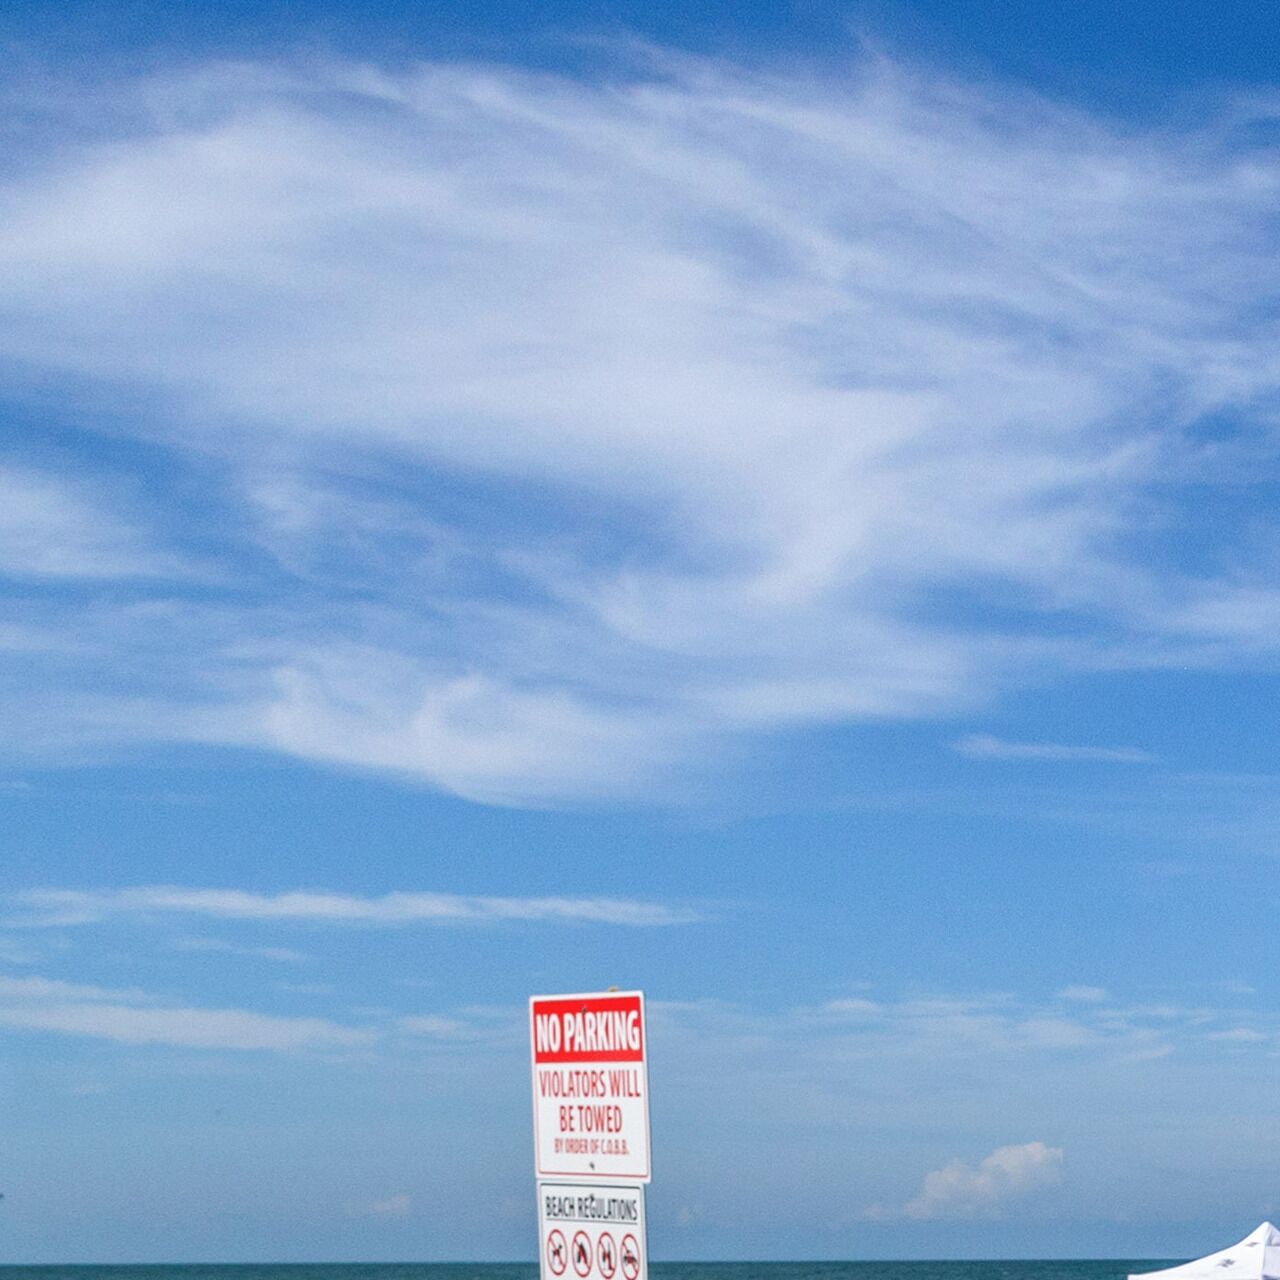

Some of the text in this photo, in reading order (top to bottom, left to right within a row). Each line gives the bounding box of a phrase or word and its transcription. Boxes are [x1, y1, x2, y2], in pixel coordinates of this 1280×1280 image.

[536, 1010, 640, 1053] NO PARKING
[540, 1069, 641, 1098] VIOLATORS WILL
[559, 1105, 623, 1133] BE TOWED
[554, 1139, 563, 1153] BY
[565, 1139, 588, 1154] ORDER
[590, 1140, 600, 1154] OF
[546, 1196, 638, 1221] BEACH REGULATIONS
